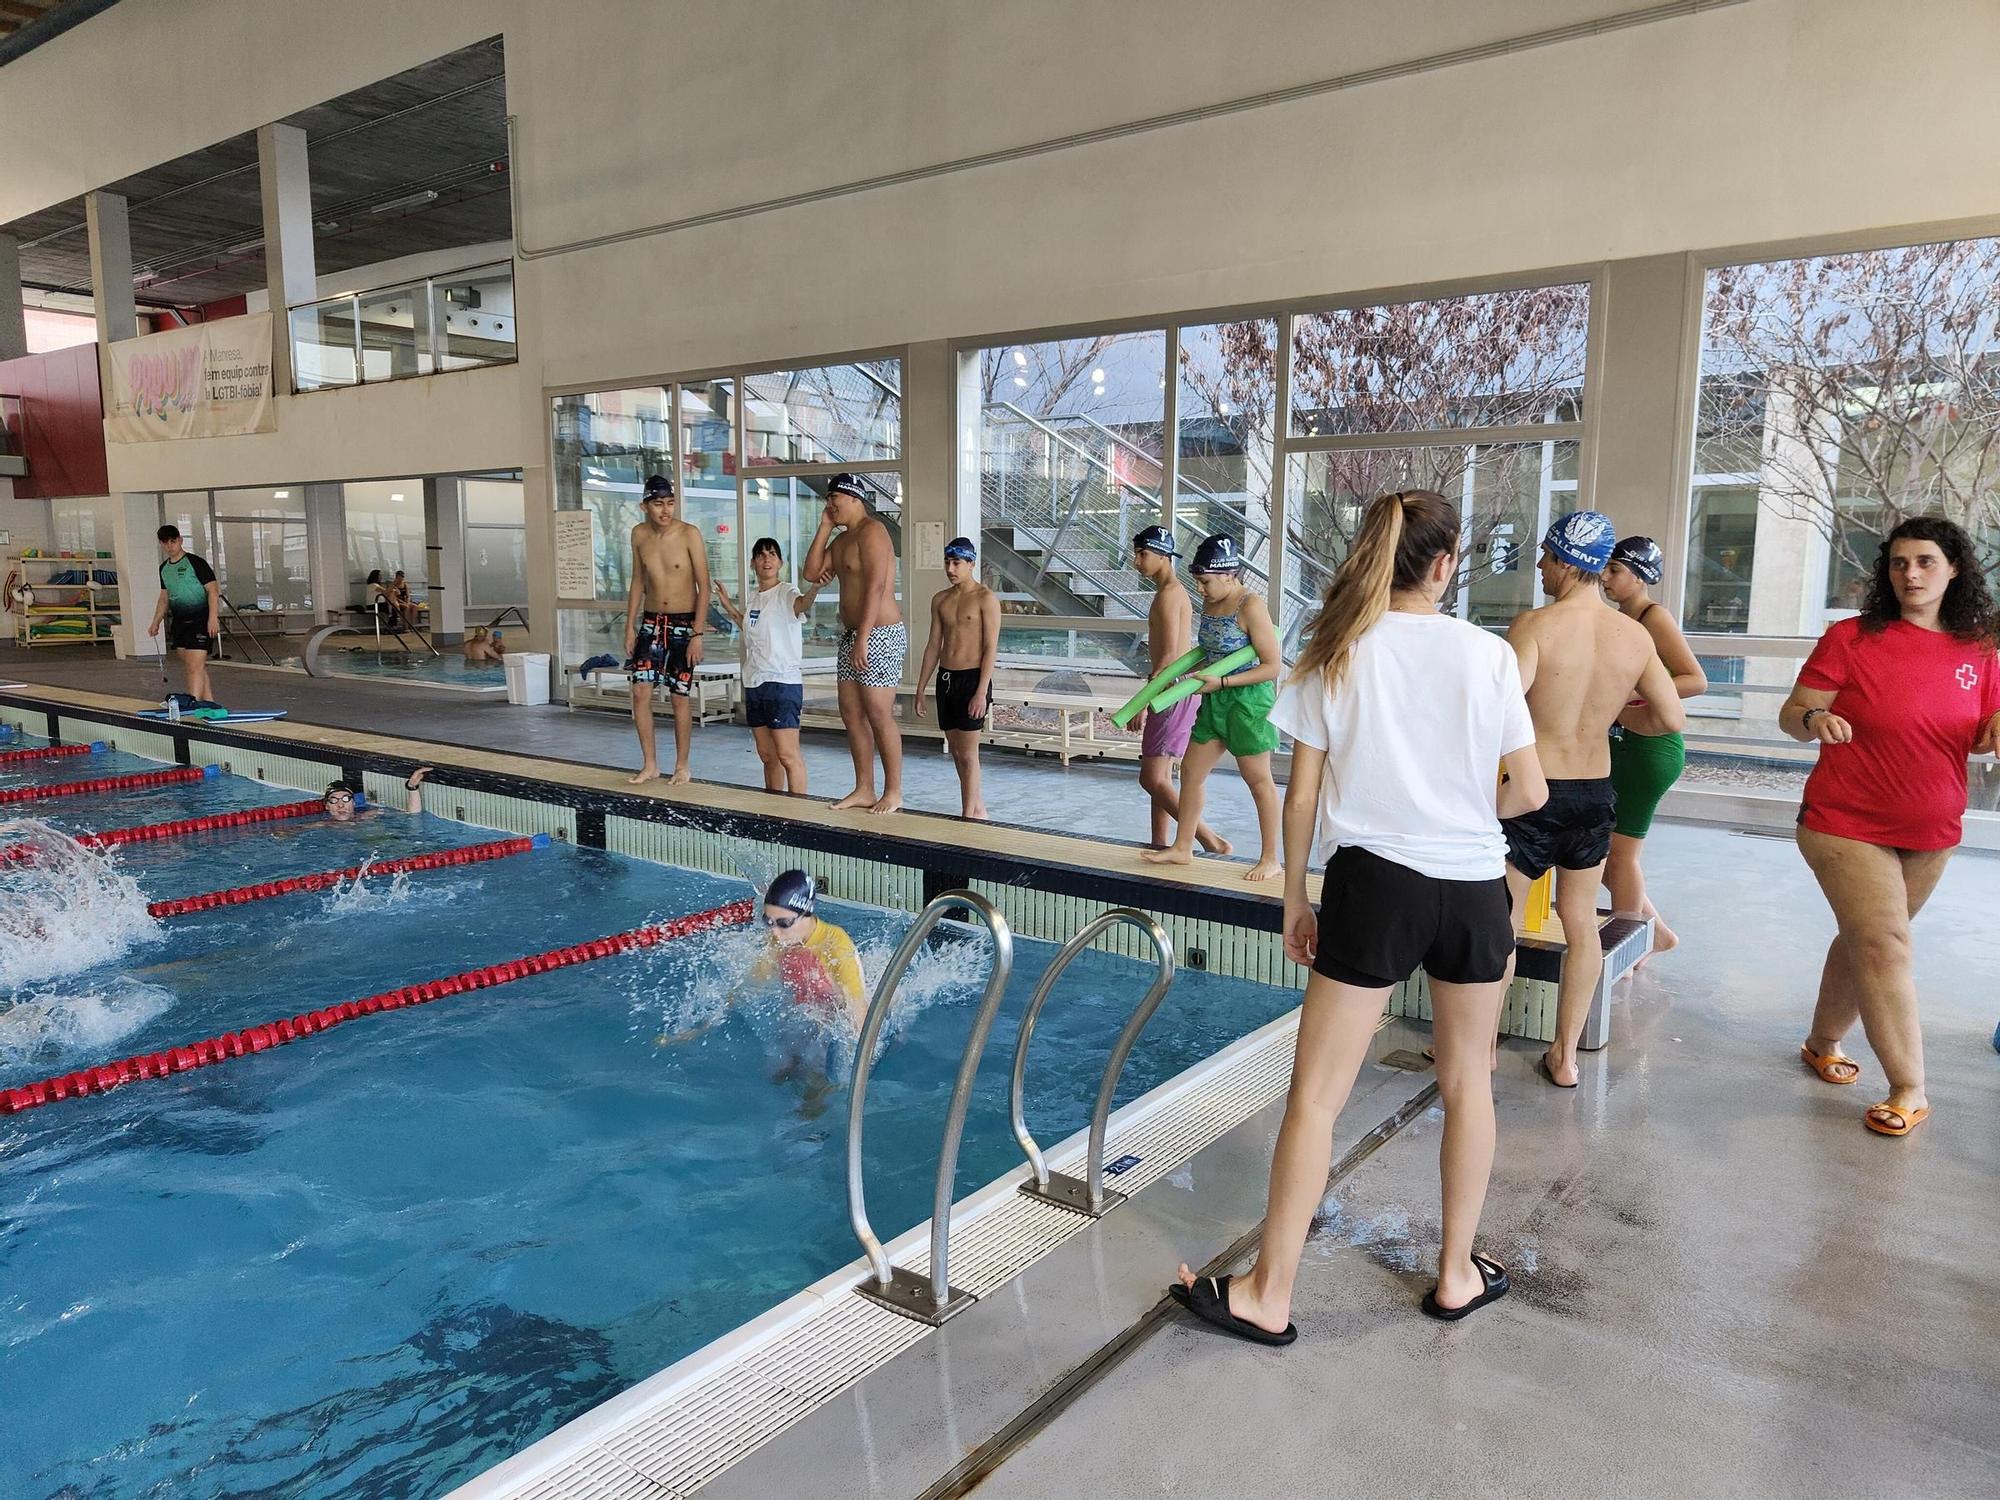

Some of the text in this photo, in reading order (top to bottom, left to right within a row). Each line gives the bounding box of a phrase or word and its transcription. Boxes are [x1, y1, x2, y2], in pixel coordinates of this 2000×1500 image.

[204, 363, 269, 382] fem equip contra
[1546, 530, 1601, 565] SALLENT
